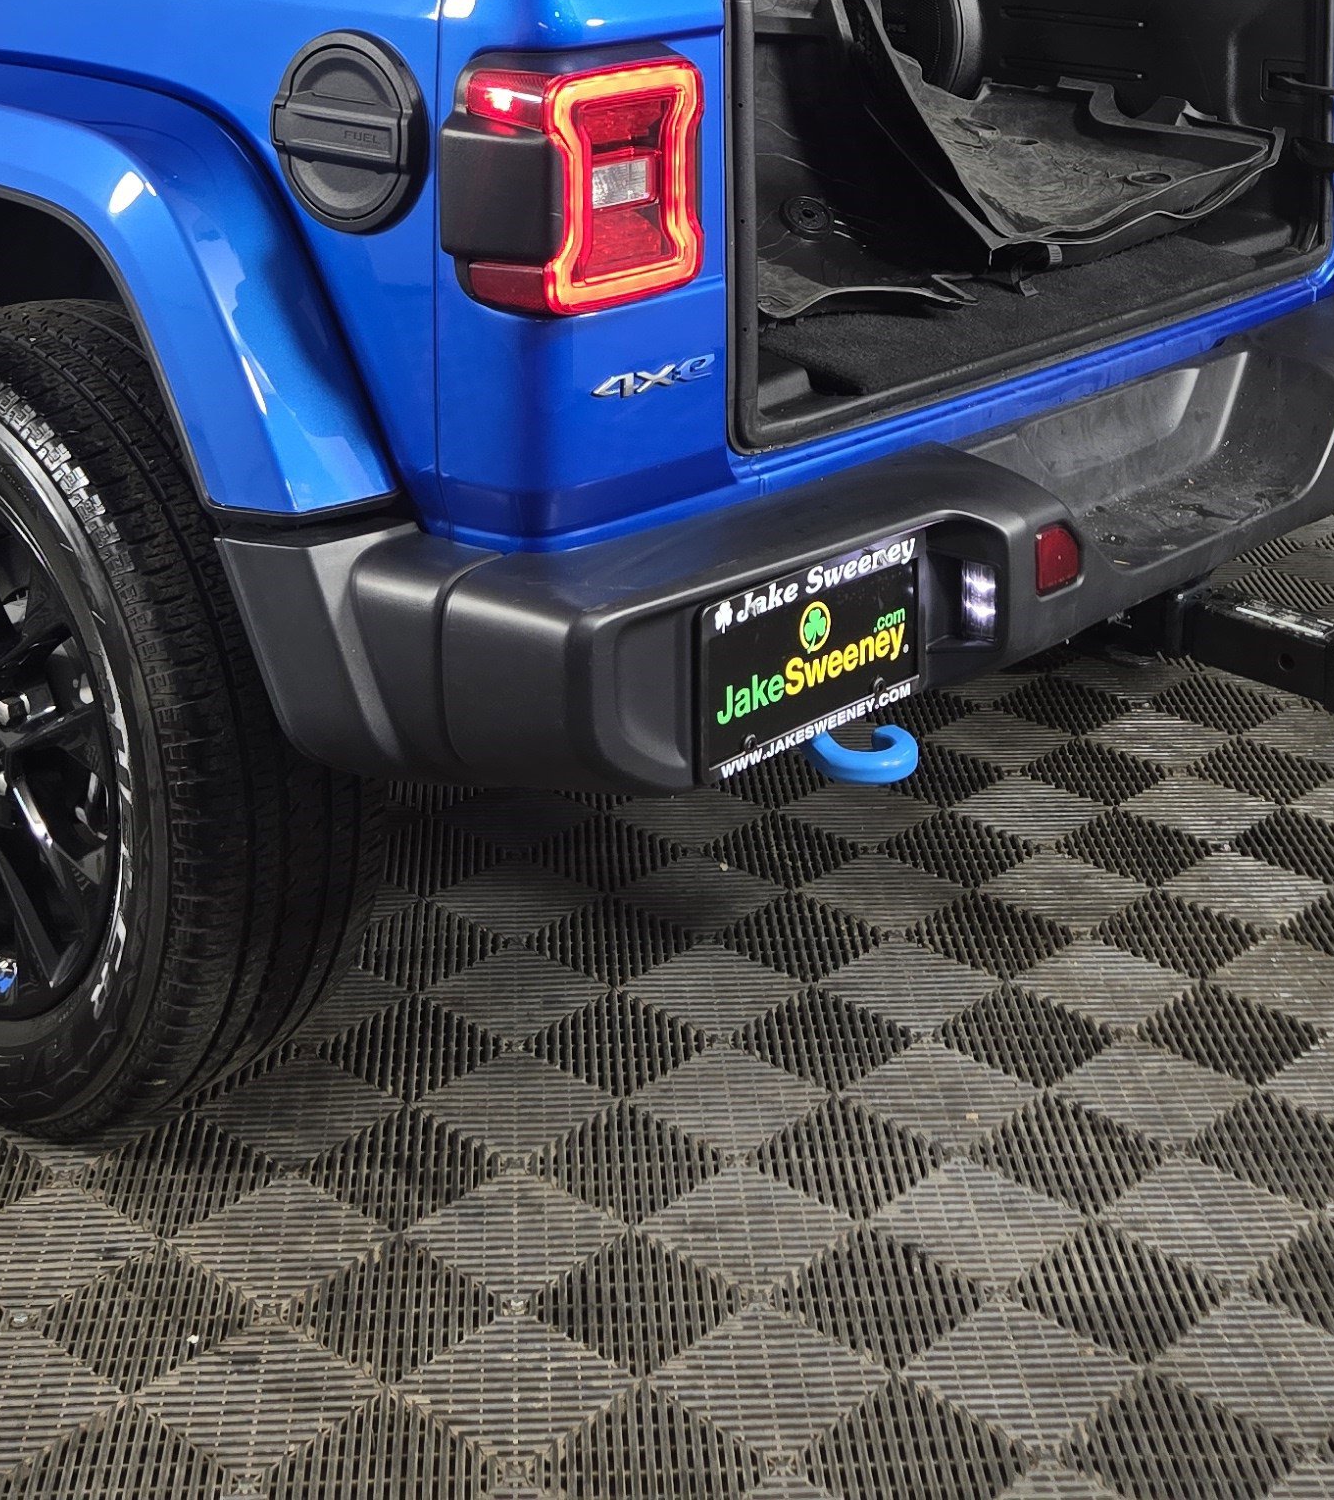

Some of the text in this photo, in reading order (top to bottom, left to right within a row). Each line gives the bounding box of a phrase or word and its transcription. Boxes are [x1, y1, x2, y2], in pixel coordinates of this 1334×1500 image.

[344, 130, 381, 145] FUEL
[736, 537, 916, 622] Jake Sweeney
[874, 607, 906, 633] .com
[720, 682, 912, 779] WWW.JAKESWEENEY.COM
